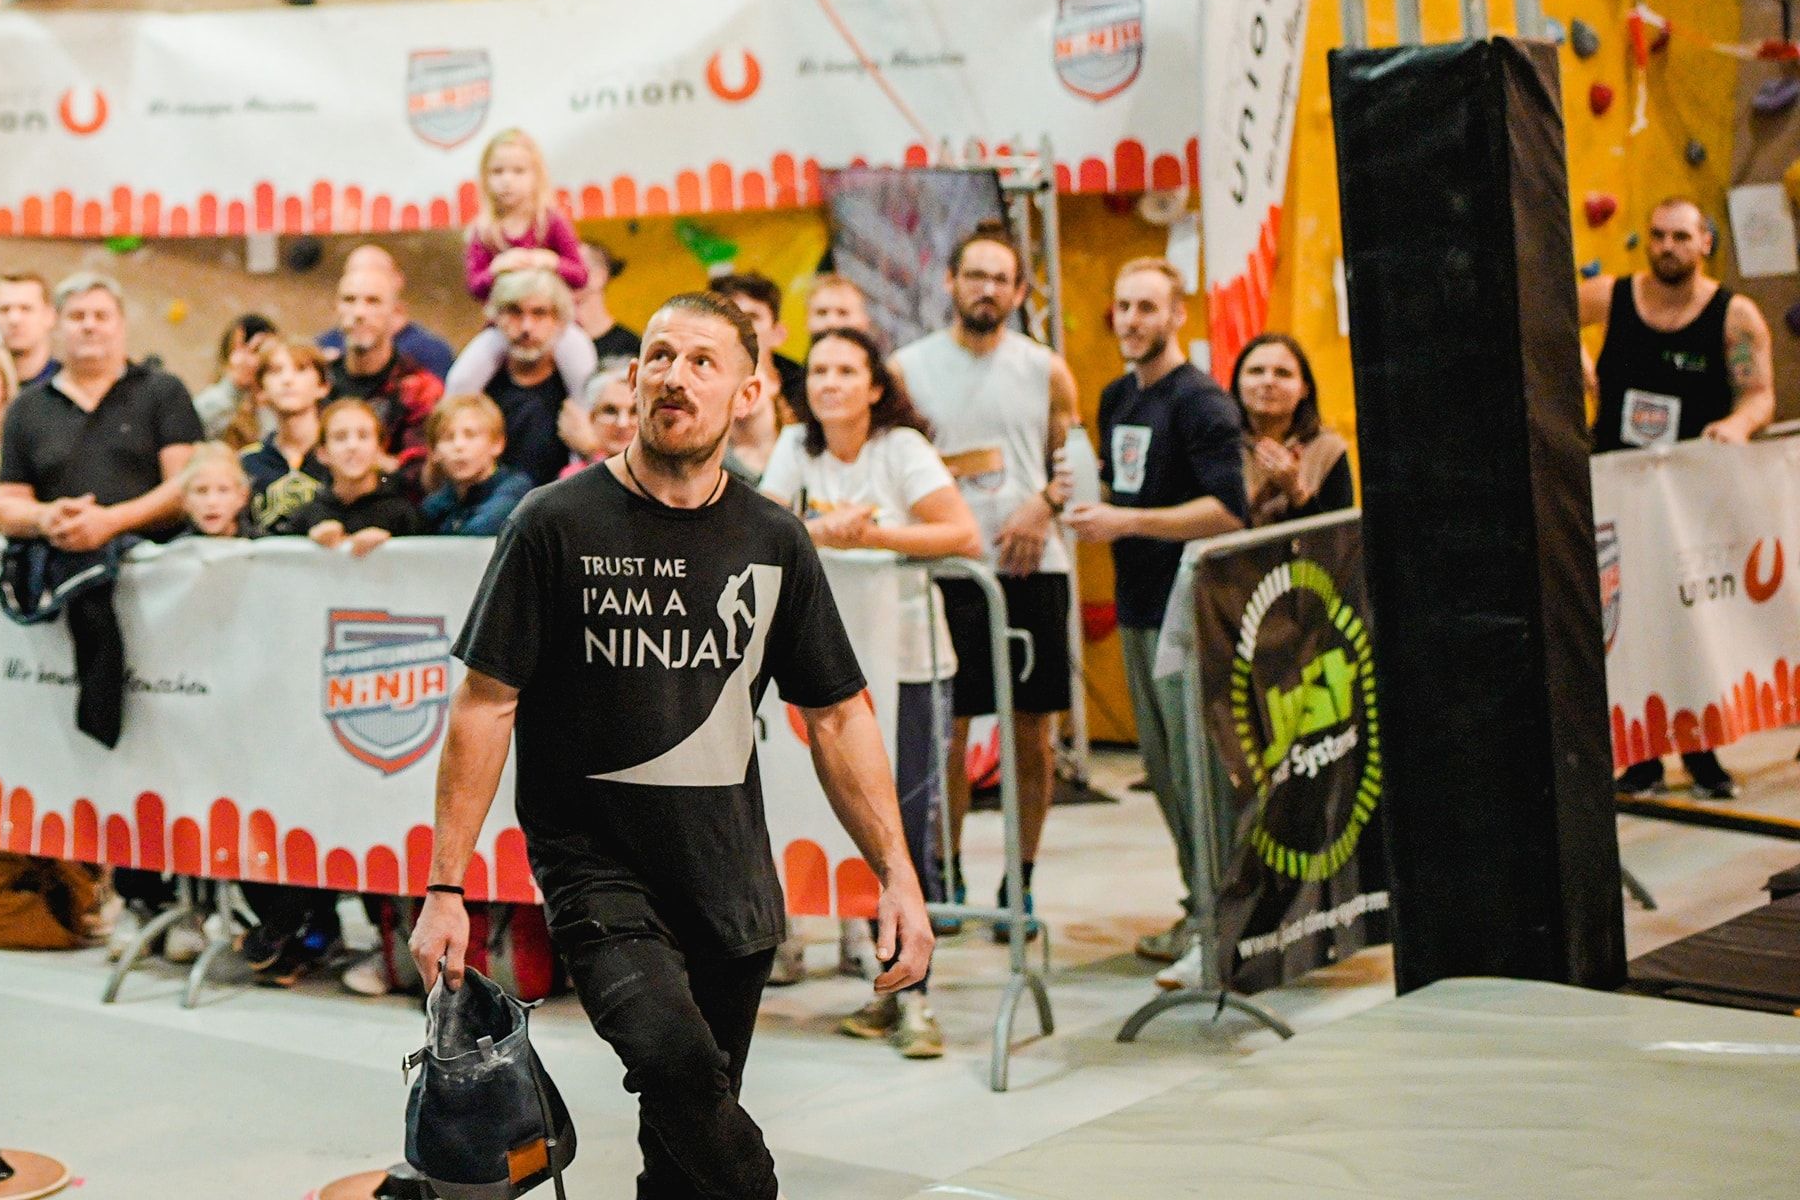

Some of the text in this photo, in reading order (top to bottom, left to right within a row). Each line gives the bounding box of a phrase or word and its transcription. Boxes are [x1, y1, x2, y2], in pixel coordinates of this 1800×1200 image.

[570, 78, 695, 110] union
[580, 556, 687, 577] TRUST ME
[583, 588, 687, 616] I'AM A
[584, 626, 721, 670] NINJA
